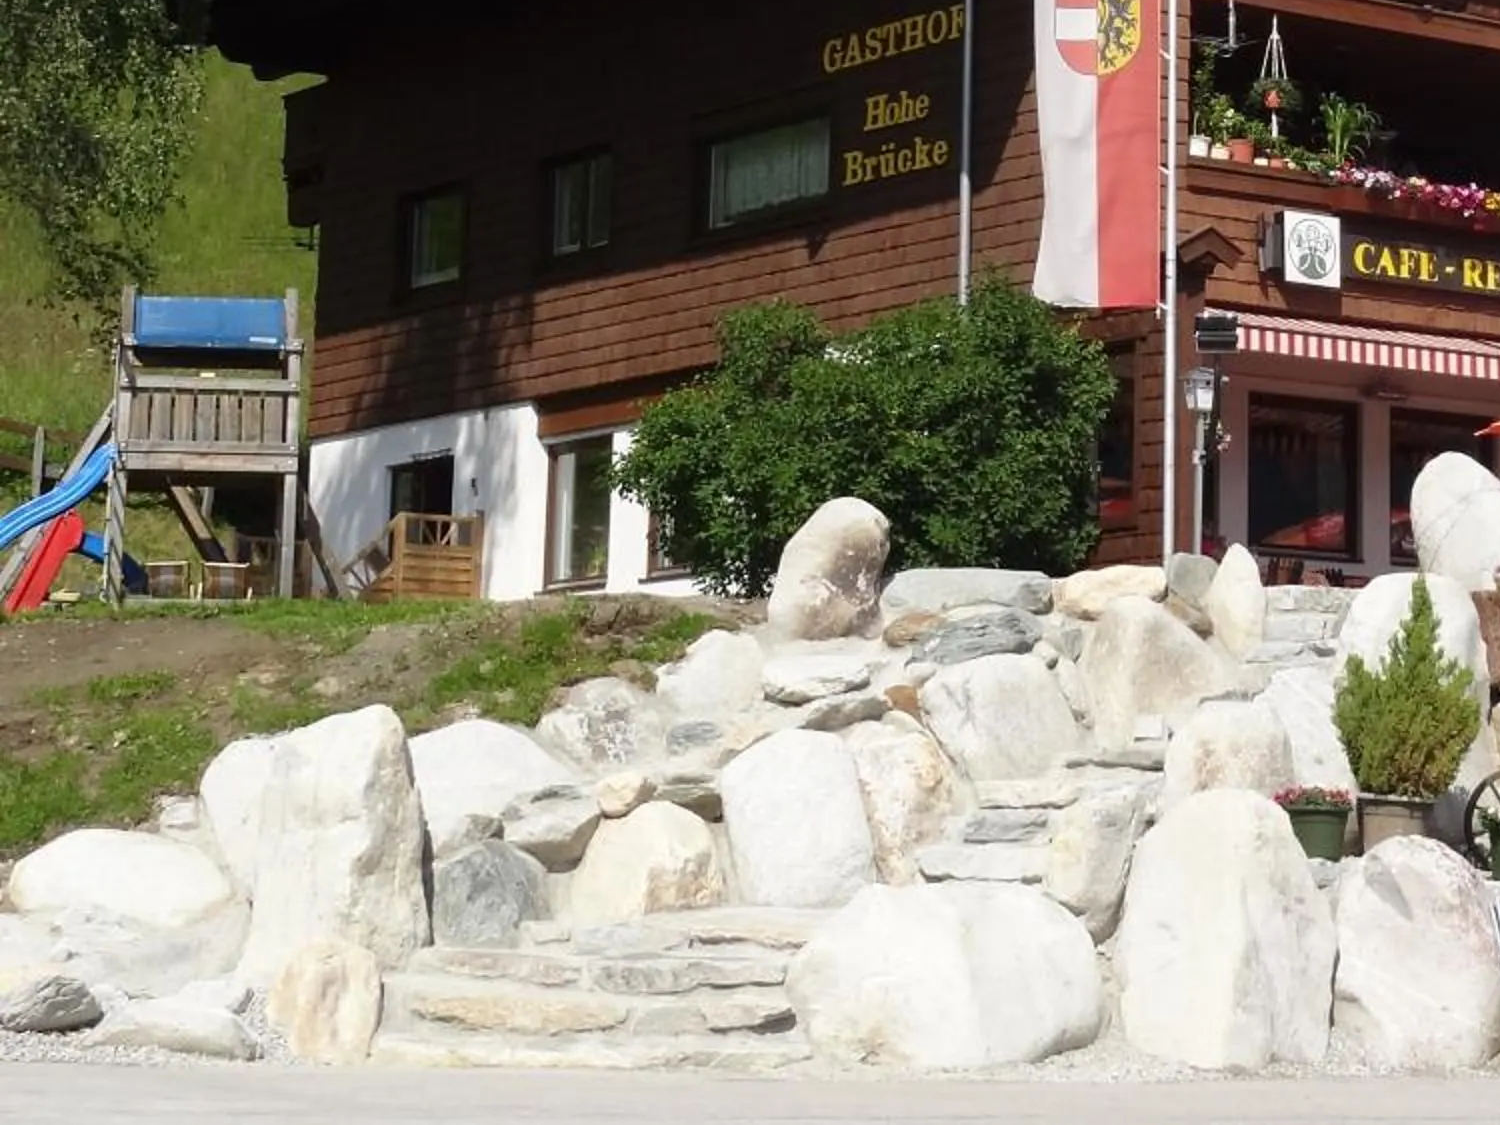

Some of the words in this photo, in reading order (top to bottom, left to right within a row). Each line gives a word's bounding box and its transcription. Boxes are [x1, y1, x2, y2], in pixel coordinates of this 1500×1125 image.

[822, 3, 965, 73] GASTHOF
[863, 90, 930, 131] Hohe
[842, 136, 949, 186] Brücke
[1353, 242, 1439, 282] CAFE
